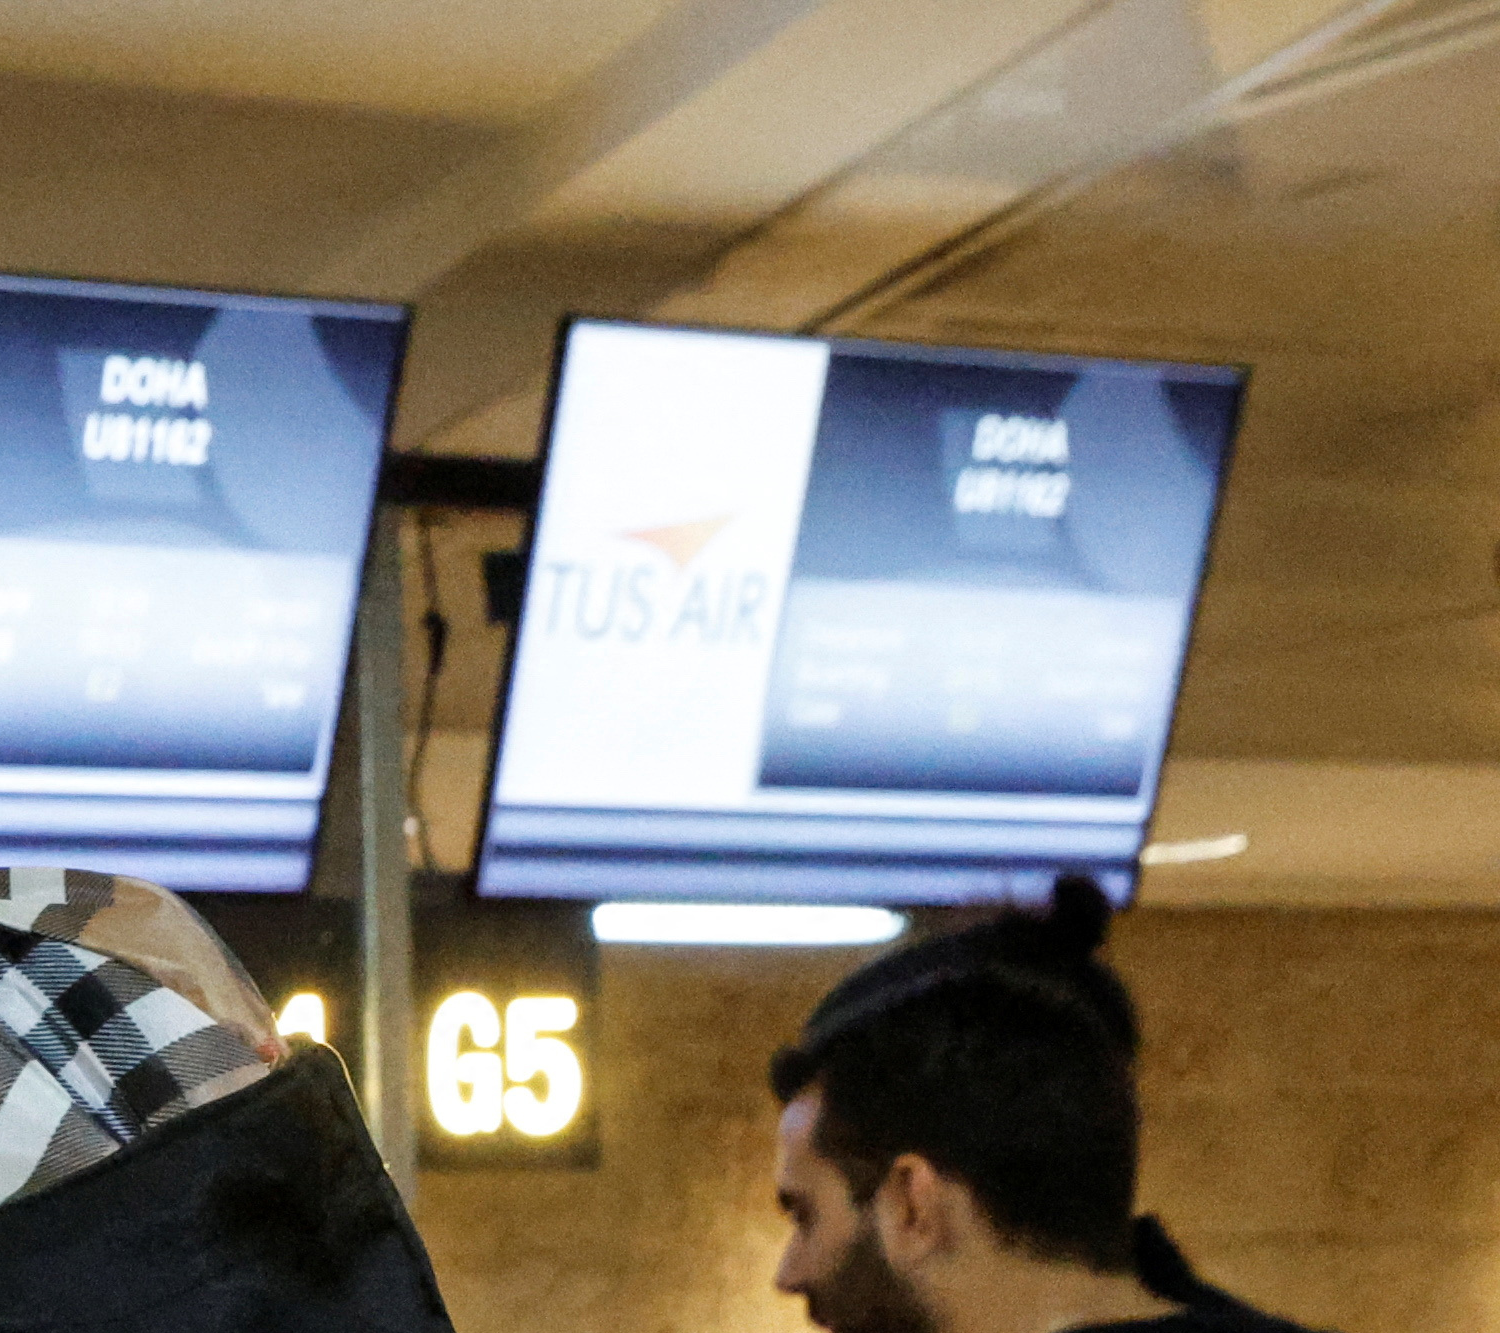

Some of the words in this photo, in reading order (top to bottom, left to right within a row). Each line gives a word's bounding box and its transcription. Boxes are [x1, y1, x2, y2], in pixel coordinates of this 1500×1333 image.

[100, 356, 208, 409] DOHA
[543, 559, 656, 643] TUS
[668, 570, 770, 645] AIR
[426, 990, 583, 1137] G5
